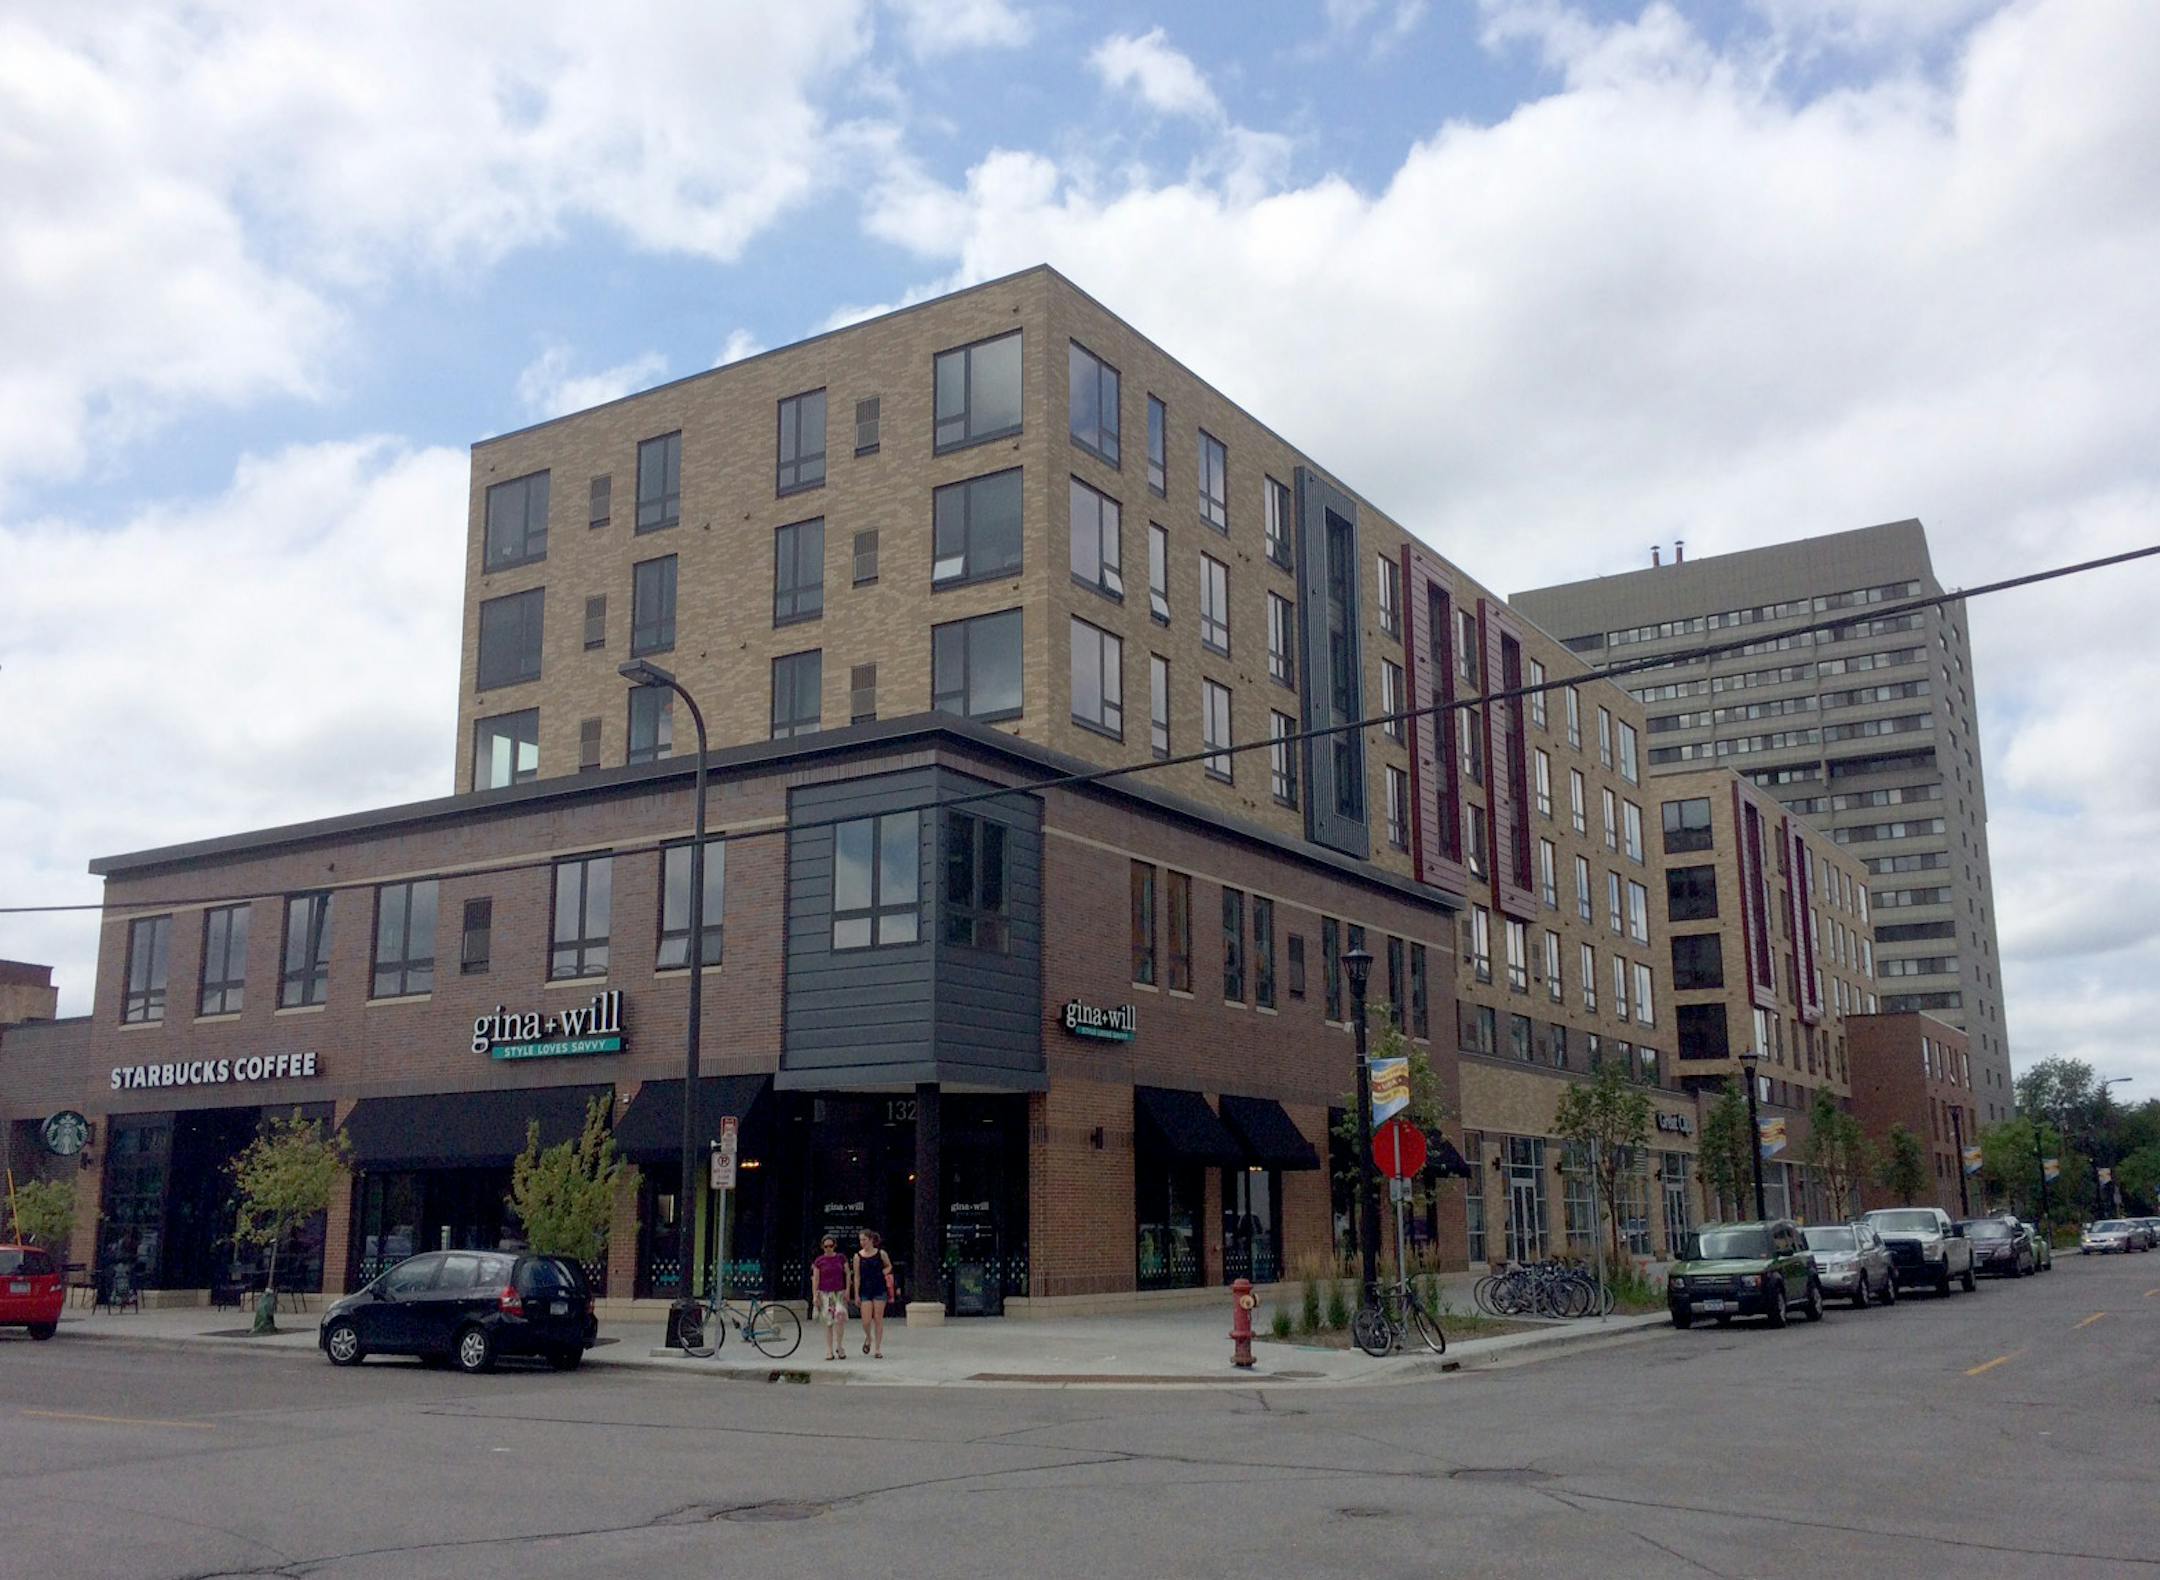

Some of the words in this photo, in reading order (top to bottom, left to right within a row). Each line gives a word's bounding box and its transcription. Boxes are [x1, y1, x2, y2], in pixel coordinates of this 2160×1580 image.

[504, 1044, 534, 1058] STYLE
[537, 1041, 569, 1055] LOVES
[572, 1039, 607, 1052] SAVVY
[111, 1059, 230, 1090] STARBUCKS
[233, 1052, 317, 1081] COFFEE
